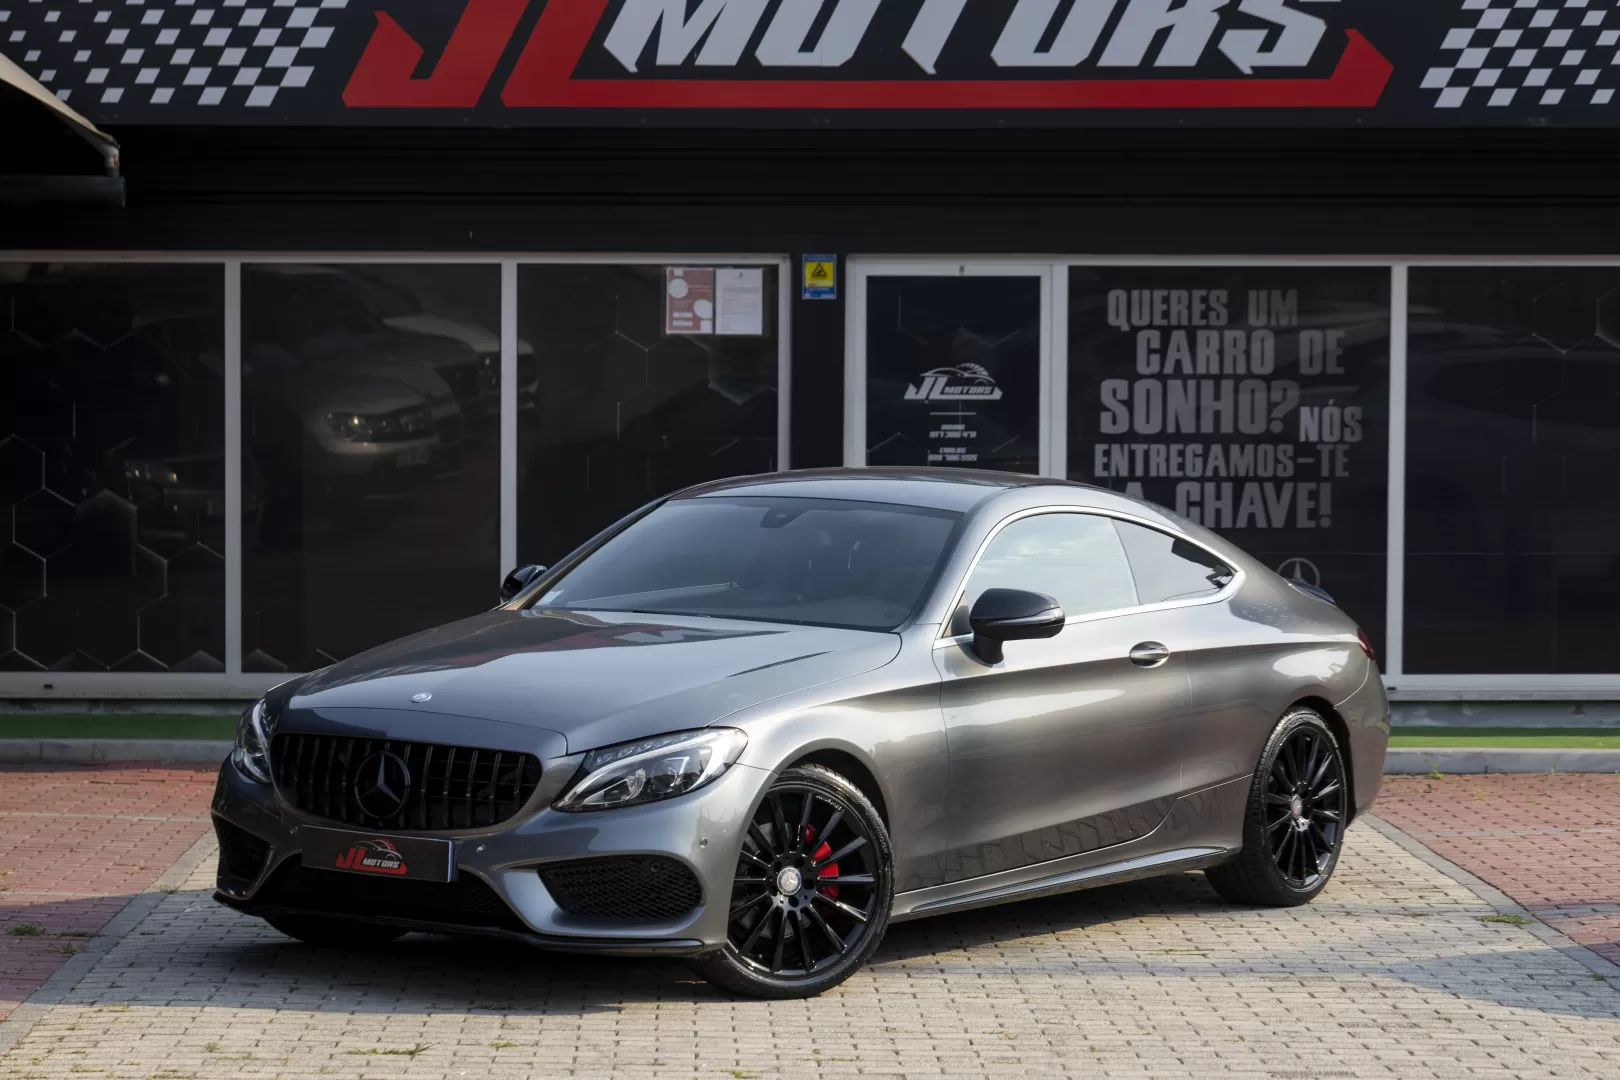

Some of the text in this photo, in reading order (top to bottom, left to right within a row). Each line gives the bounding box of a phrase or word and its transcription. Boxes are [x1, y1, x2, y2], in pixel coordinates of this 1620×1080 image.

[603, 0, 1341, 74] MOTORS
[1107, 289, 1298, 331] QUERES UM
[1136, 330, 1345, 375] CARRO DE
[943, 386, 992, 394] MOTORS
[1100, 379, 1363, 442] SONHO? NÓS
[1094, 444, 1350, 477] ENTREGAMOS-TE
[1175, 482, 1332, 528] CHAVE!
[362, 857, 400, 869] MOTORS
